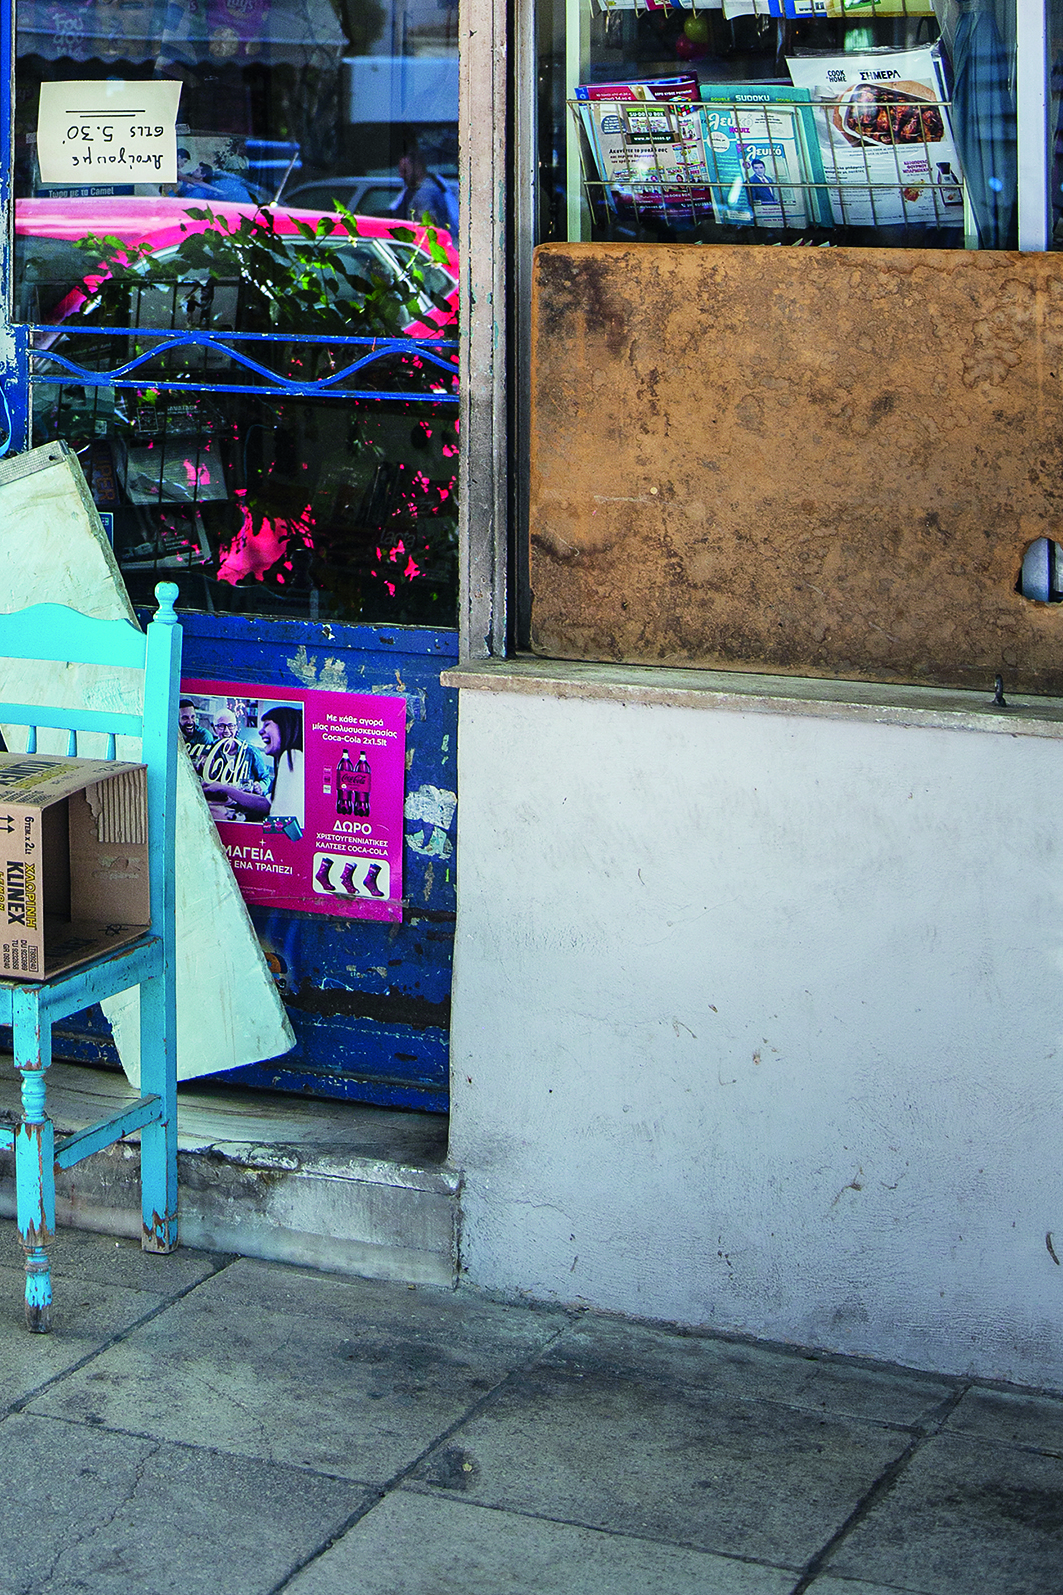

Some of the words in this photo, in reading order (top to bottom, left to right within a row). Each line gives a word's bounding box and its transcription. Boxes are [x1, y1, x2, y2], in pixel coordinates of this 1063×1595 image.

[735, 94, 771, 102] SUDOKU
[90, 186, 114, 196] Camel
[311, 722, 329, 732] μίας
[326, 714, 338, 723] Με
[338, 715, 358, 725] κάθε
[358, 718, 384, 728] αγορά
[322, 733, 362, 745] Coca-Cola
[332, 819, 373, 836] ΔΩΡΟ
[316, 832, 389, 848] ΧΡΙΣΤΟΥΓΕΝΝΙΑΤΙΚΕΣ
[315, 841, 347, 852] ΚΑΛΤΣΕΣ
[347, 845, 389, 857] COCA-COLA
[234, 860, 253, 870] ΕΝΑ
[254, 862, 293, 875] ΤΡΑΠΕΖΙ
[6, 860, 26, 926] KLINEX
[24, 861, 37, 930] ΧΛΩΡΙΝΗ
[3, 943, 10, 953] GR
[11, 939, 19, 948] TU
